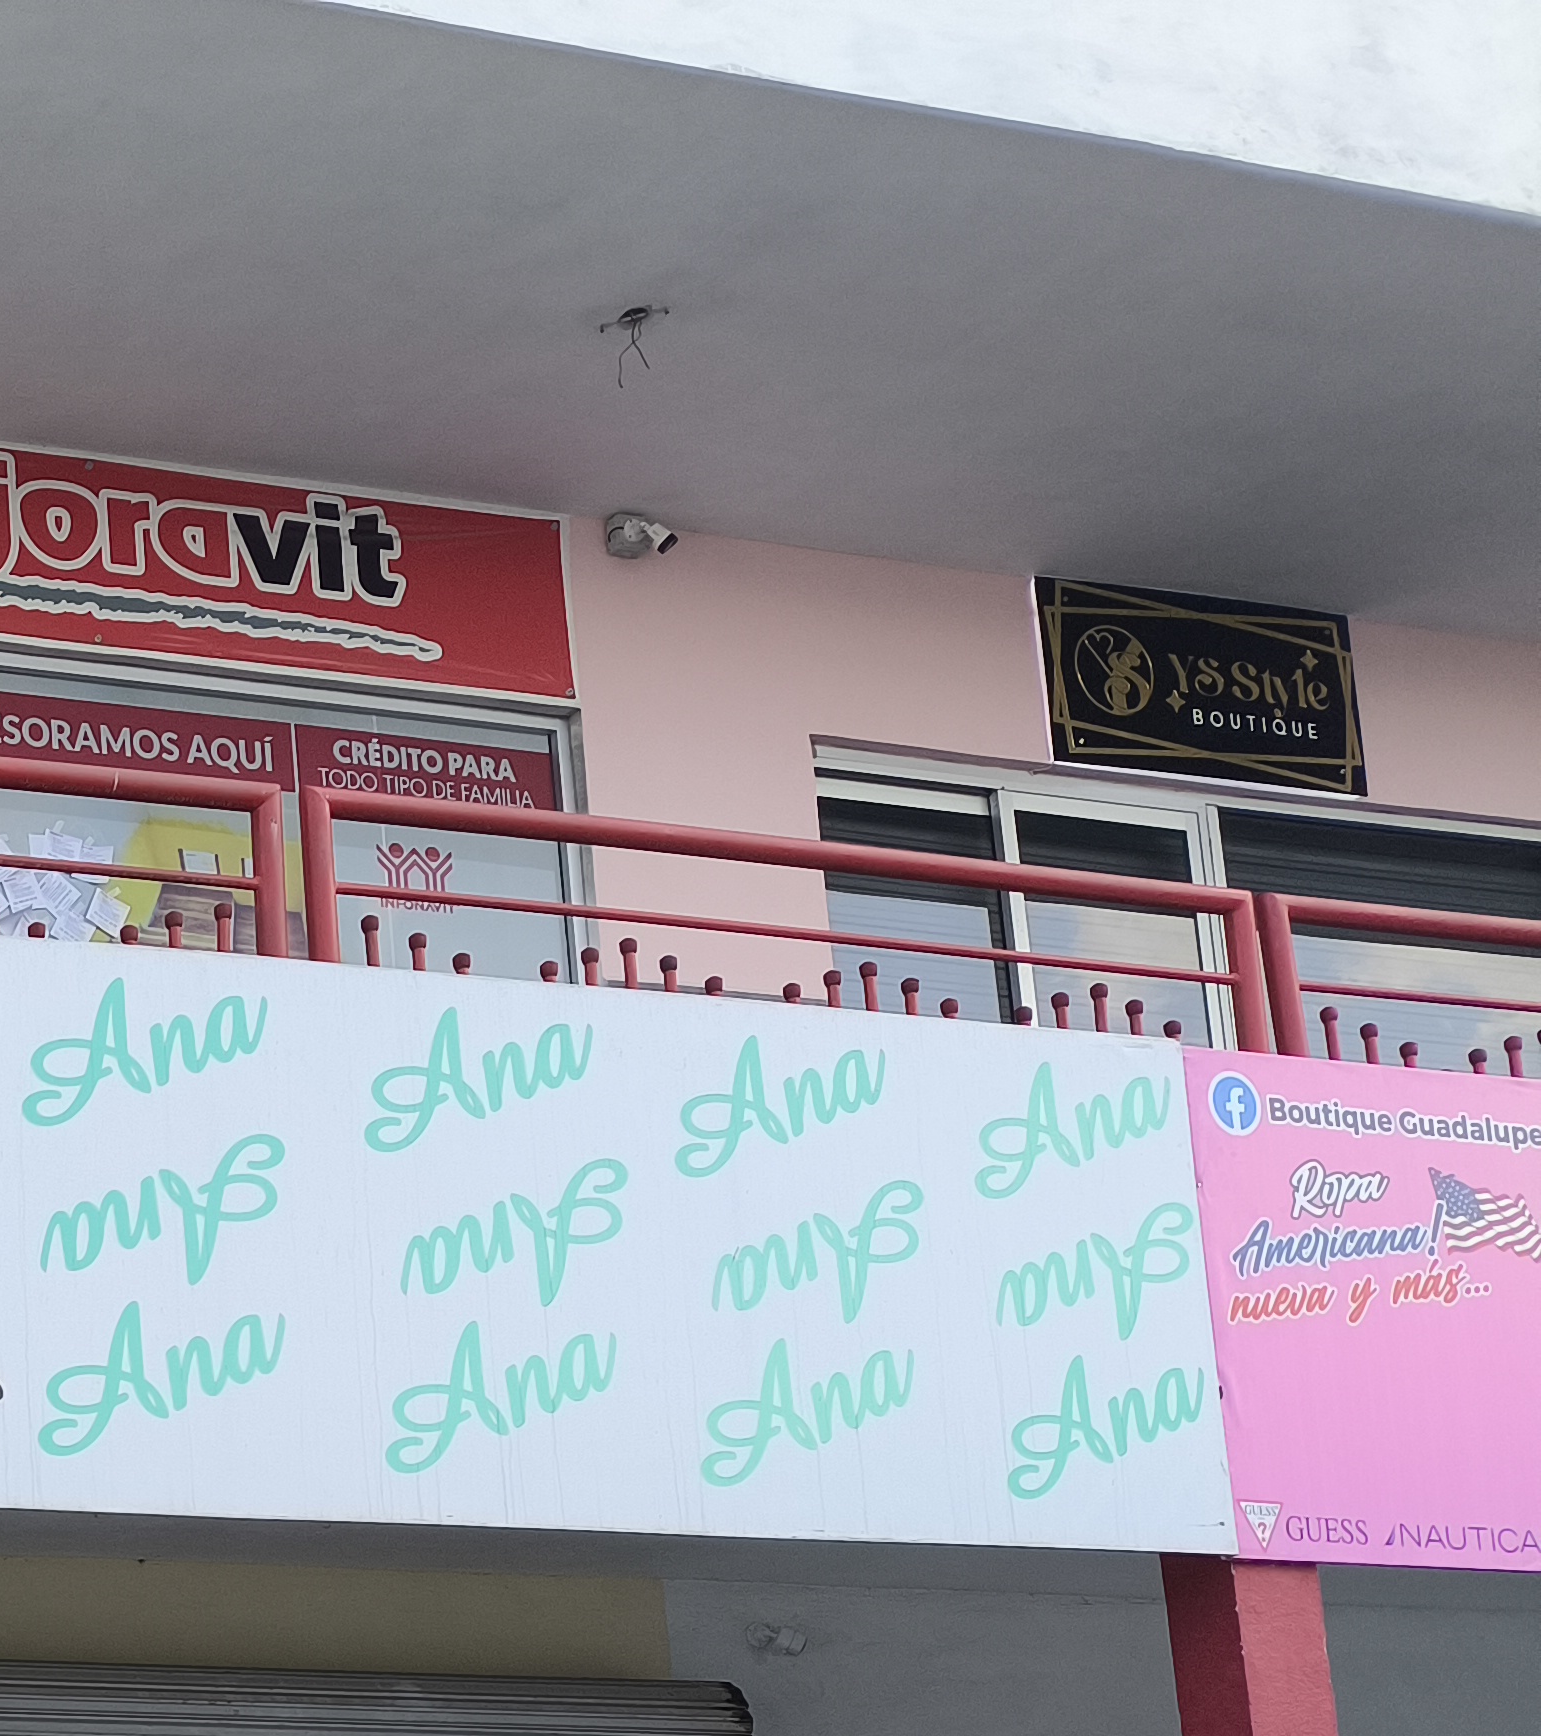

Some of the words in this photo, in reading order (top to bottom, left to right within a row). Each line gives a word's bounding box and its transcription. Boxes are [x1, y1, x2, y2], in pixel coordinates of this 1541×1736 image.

[186, 735, 275, 773] AQUÍ
[317, 766, 378, 790] TODO
[381, 773, 428, 796] TIPO
[432, 778, 458, 801] DE
[459, 782, 536, 811] FAMILIA
[332, 737, 443, 775] CRÉDITO
[445, 751, 517, 783] PARA
[1192, 708, 1319, 740] BOUTIQUE
[23, 979, 267, 1127] Ana
[365, 1009, 592, 1152] Ana
[676, 1037, 885, 1177] Ana
[978, 1066, 1170, 1199] Ana
[1268, 1097, 1392, 1136] Boutique
[1398, 1110, 1541, 1150] Guadalupe
[1290, 1158, 1389, 1218] Ropa
[41, 1134, 285, 1286] Ana
[401, 1160, 627, 1307] Ana
[713, 1181, 924, 1323] Ana
[996, 1203, 1193, 1341] Ana
[1232, 1201, 1446, 1278] Americana!
[1229, 1283, 1335, 1324] nueva
[1348, 1274, 1379, 1324] y
[39, 1302, 285, 1456] Ana
[385, 1323, 617, 1474] Ana
[702, 1341, 914, 1487] Ana
[1007, 1354, 1204, 1499] Ana
[1285, 1516, 1369, 1546] GUESS
